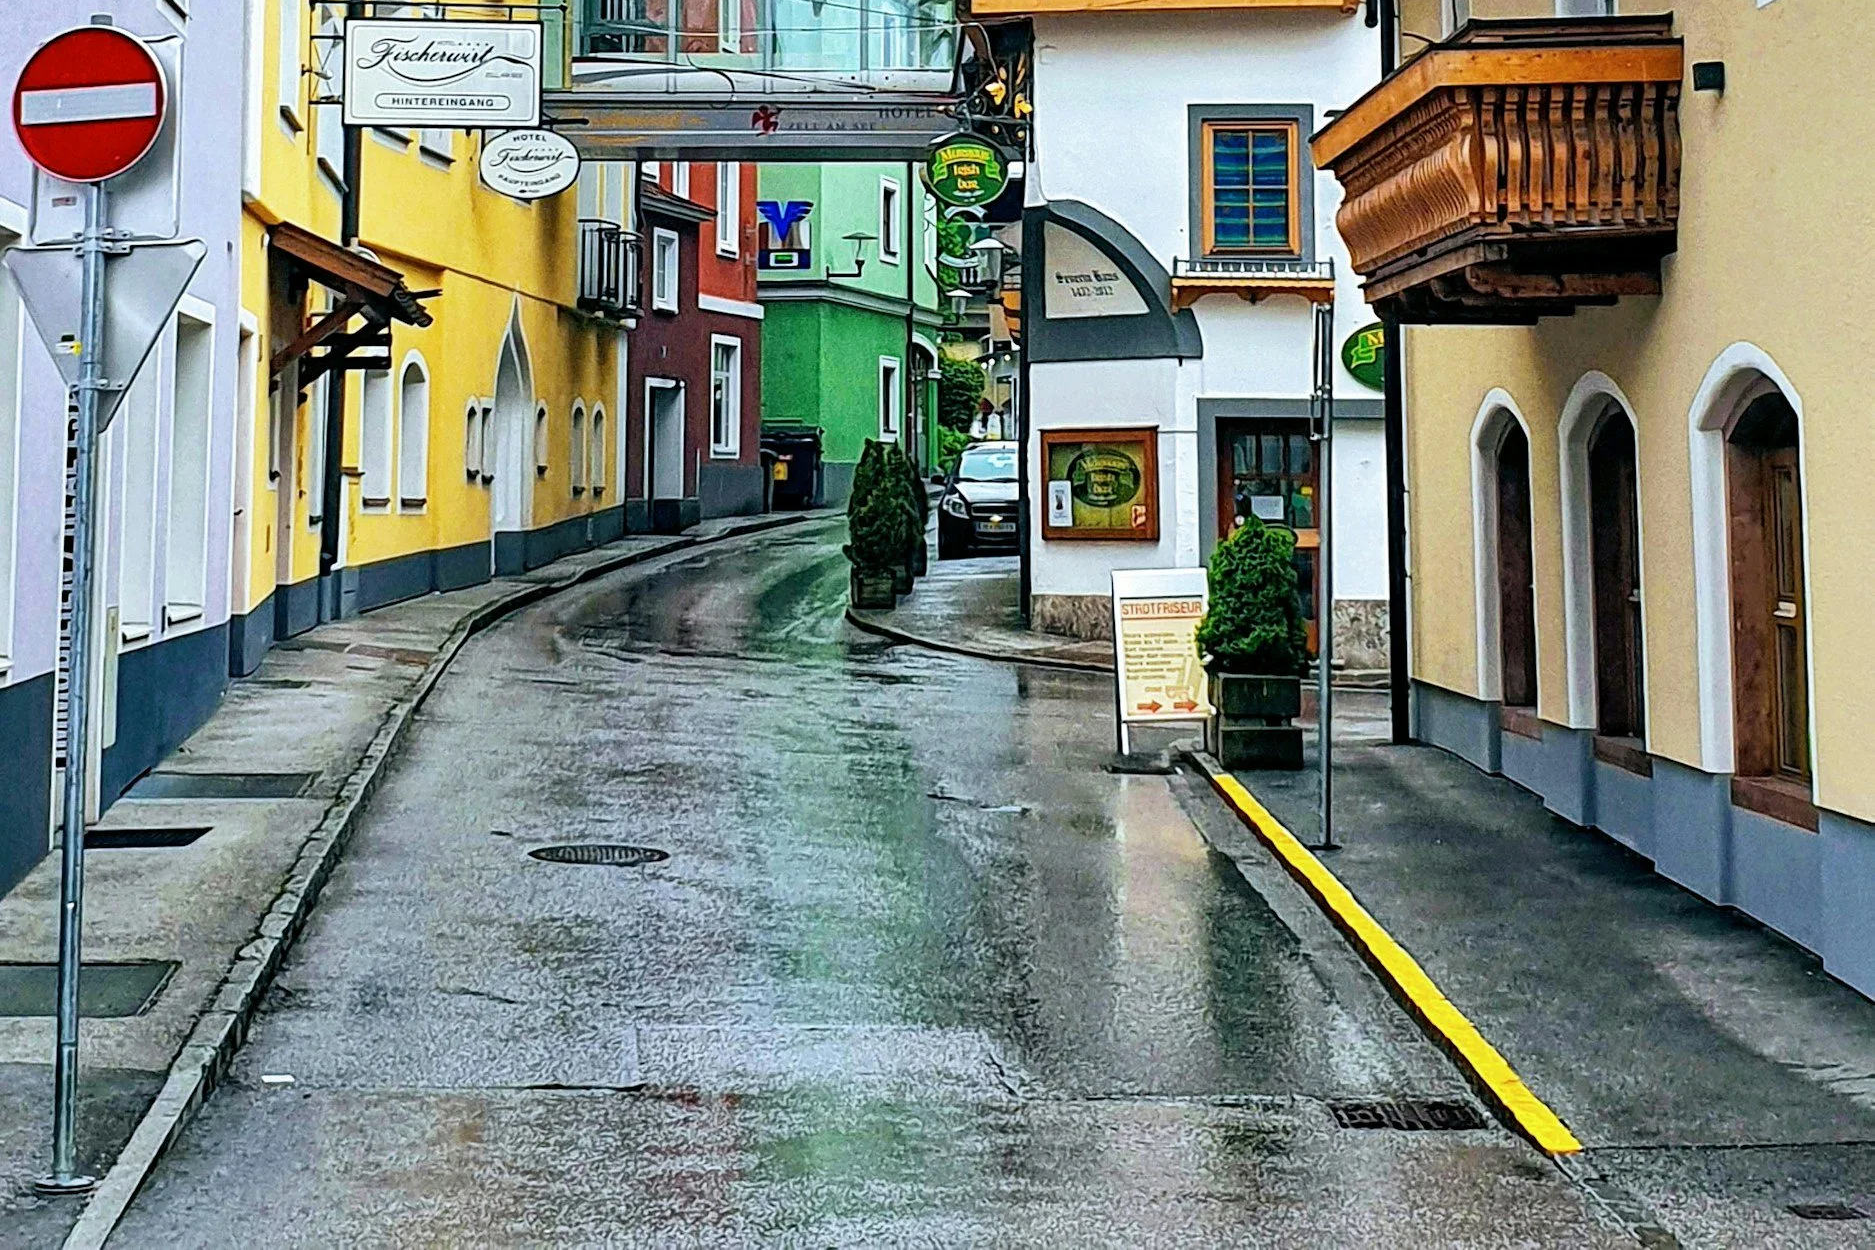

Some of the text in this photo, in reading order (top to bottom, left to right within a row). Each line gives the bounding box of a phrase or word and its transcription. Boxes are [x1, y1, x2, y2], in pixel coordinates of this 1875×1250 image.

[356, 35, 495, 70] Fischerwirt
[391, 97, 494, 107] HINTEREINGANG
[878, 107, 936, 119] HOTEL
[513, 133, 547, 142] HOTEL
